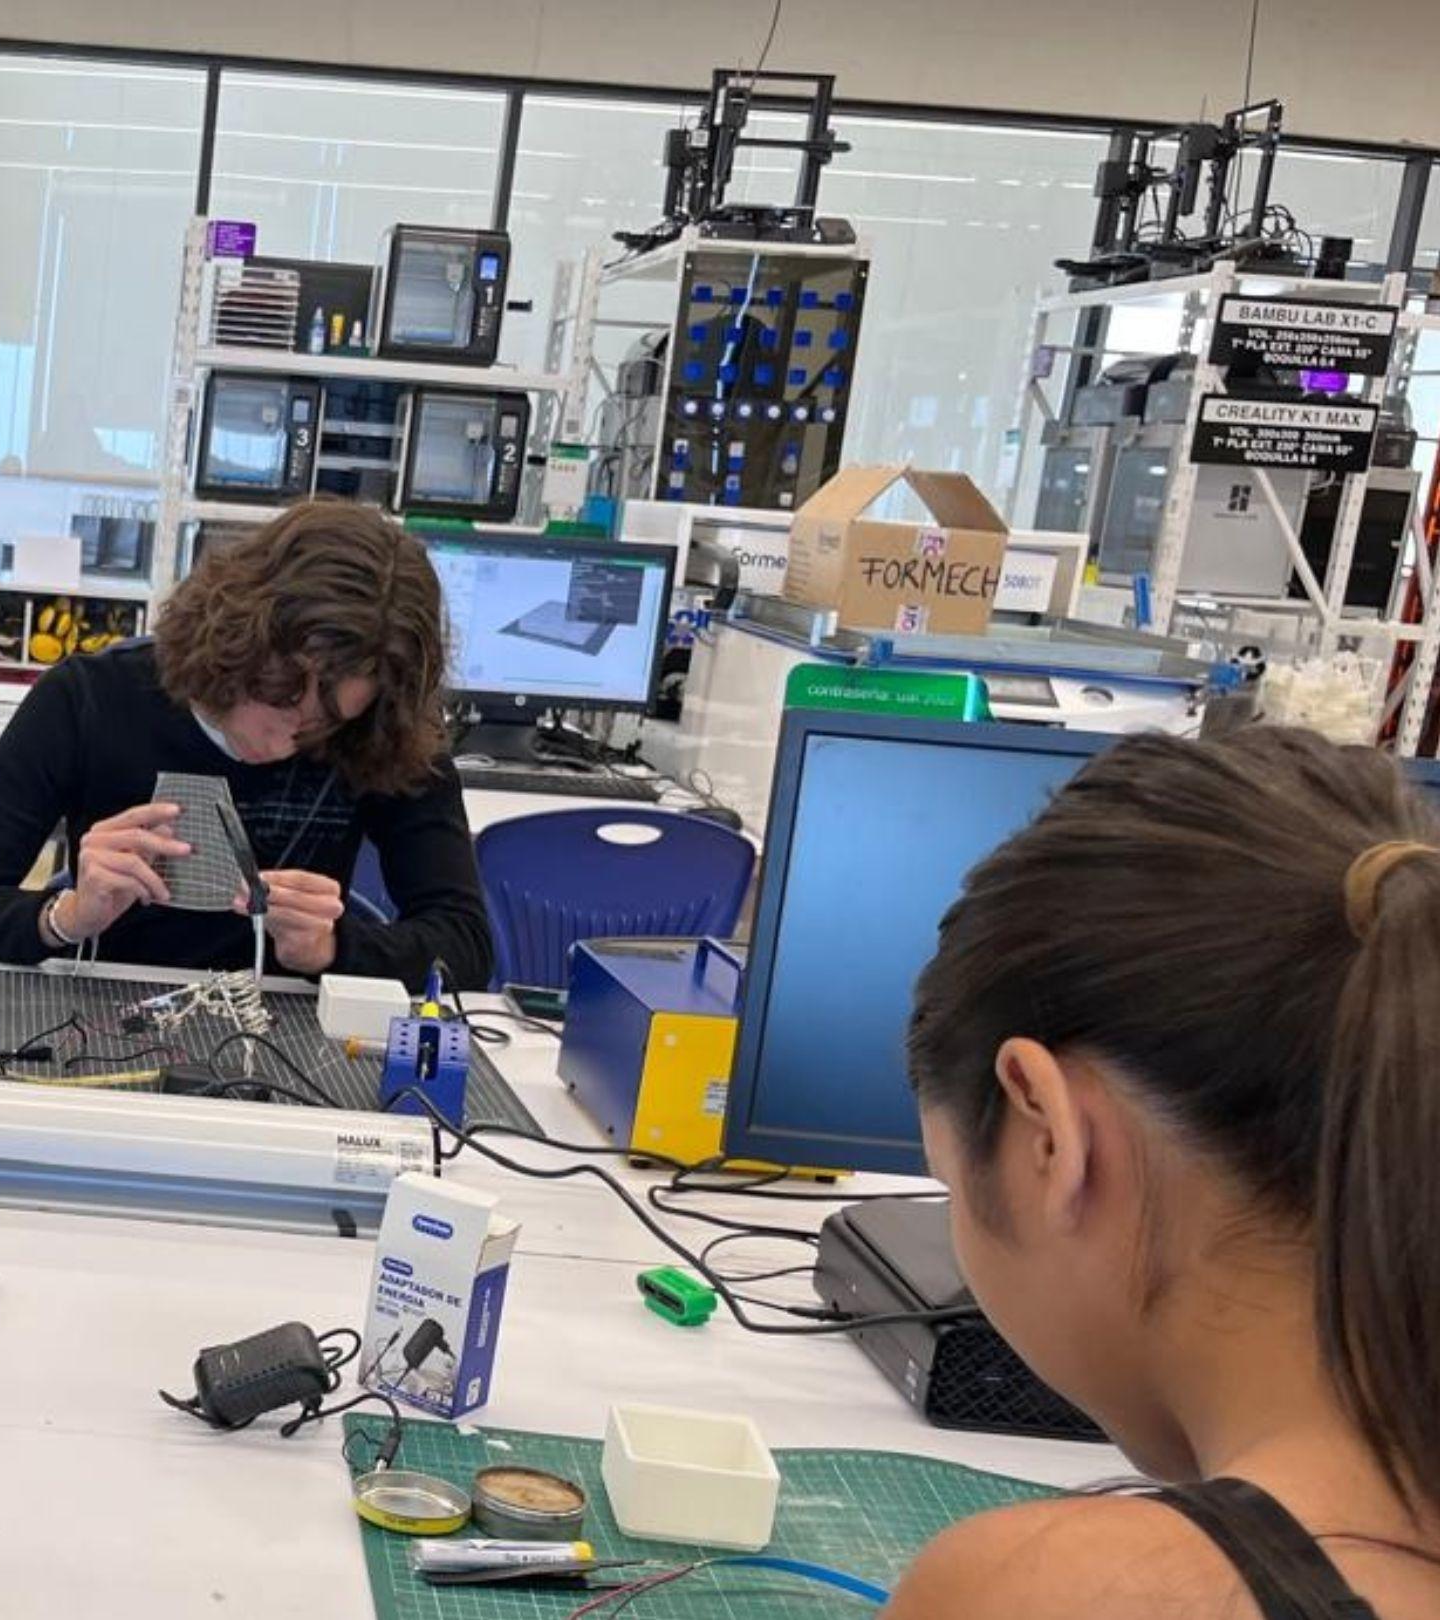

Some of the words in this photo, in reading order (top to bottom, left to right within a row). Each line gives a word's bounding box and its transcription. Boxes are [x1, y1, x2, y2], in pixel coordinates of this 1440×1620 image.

[484, 287, 495, 305] 1
[1238, 305, 1299, 324] BAMBU
[1302, 310, 1336, 325] LAB
[1340, 314, 1377, 329] X1-C
[1246, 340, 1266, 351] PLA
[1321, 345, 1352, 358] CAMA
[1263, 352, 1317, 366] BOQUILLA
[1216, 404, 1300, 422] CREALITY
[1302, 408, 1321, 423] K1
[1325, 410, 1361, 426] MAX
[297, 428, 309, 447] 3
[1226, 438, 1247, 449] PLA
[1302, 443, 1333, 454] CAMA
[503, 442, 517, 463] 2
[1244, 450, 1299, 463] BOQUILLA
[857, 556, 999, 599] FORMECH
[337, 1135, 381, 1148] HALUX
[379, 1272, 444, 1301] ADAPTADOR
[446, 1294, 462, 1308] DE
